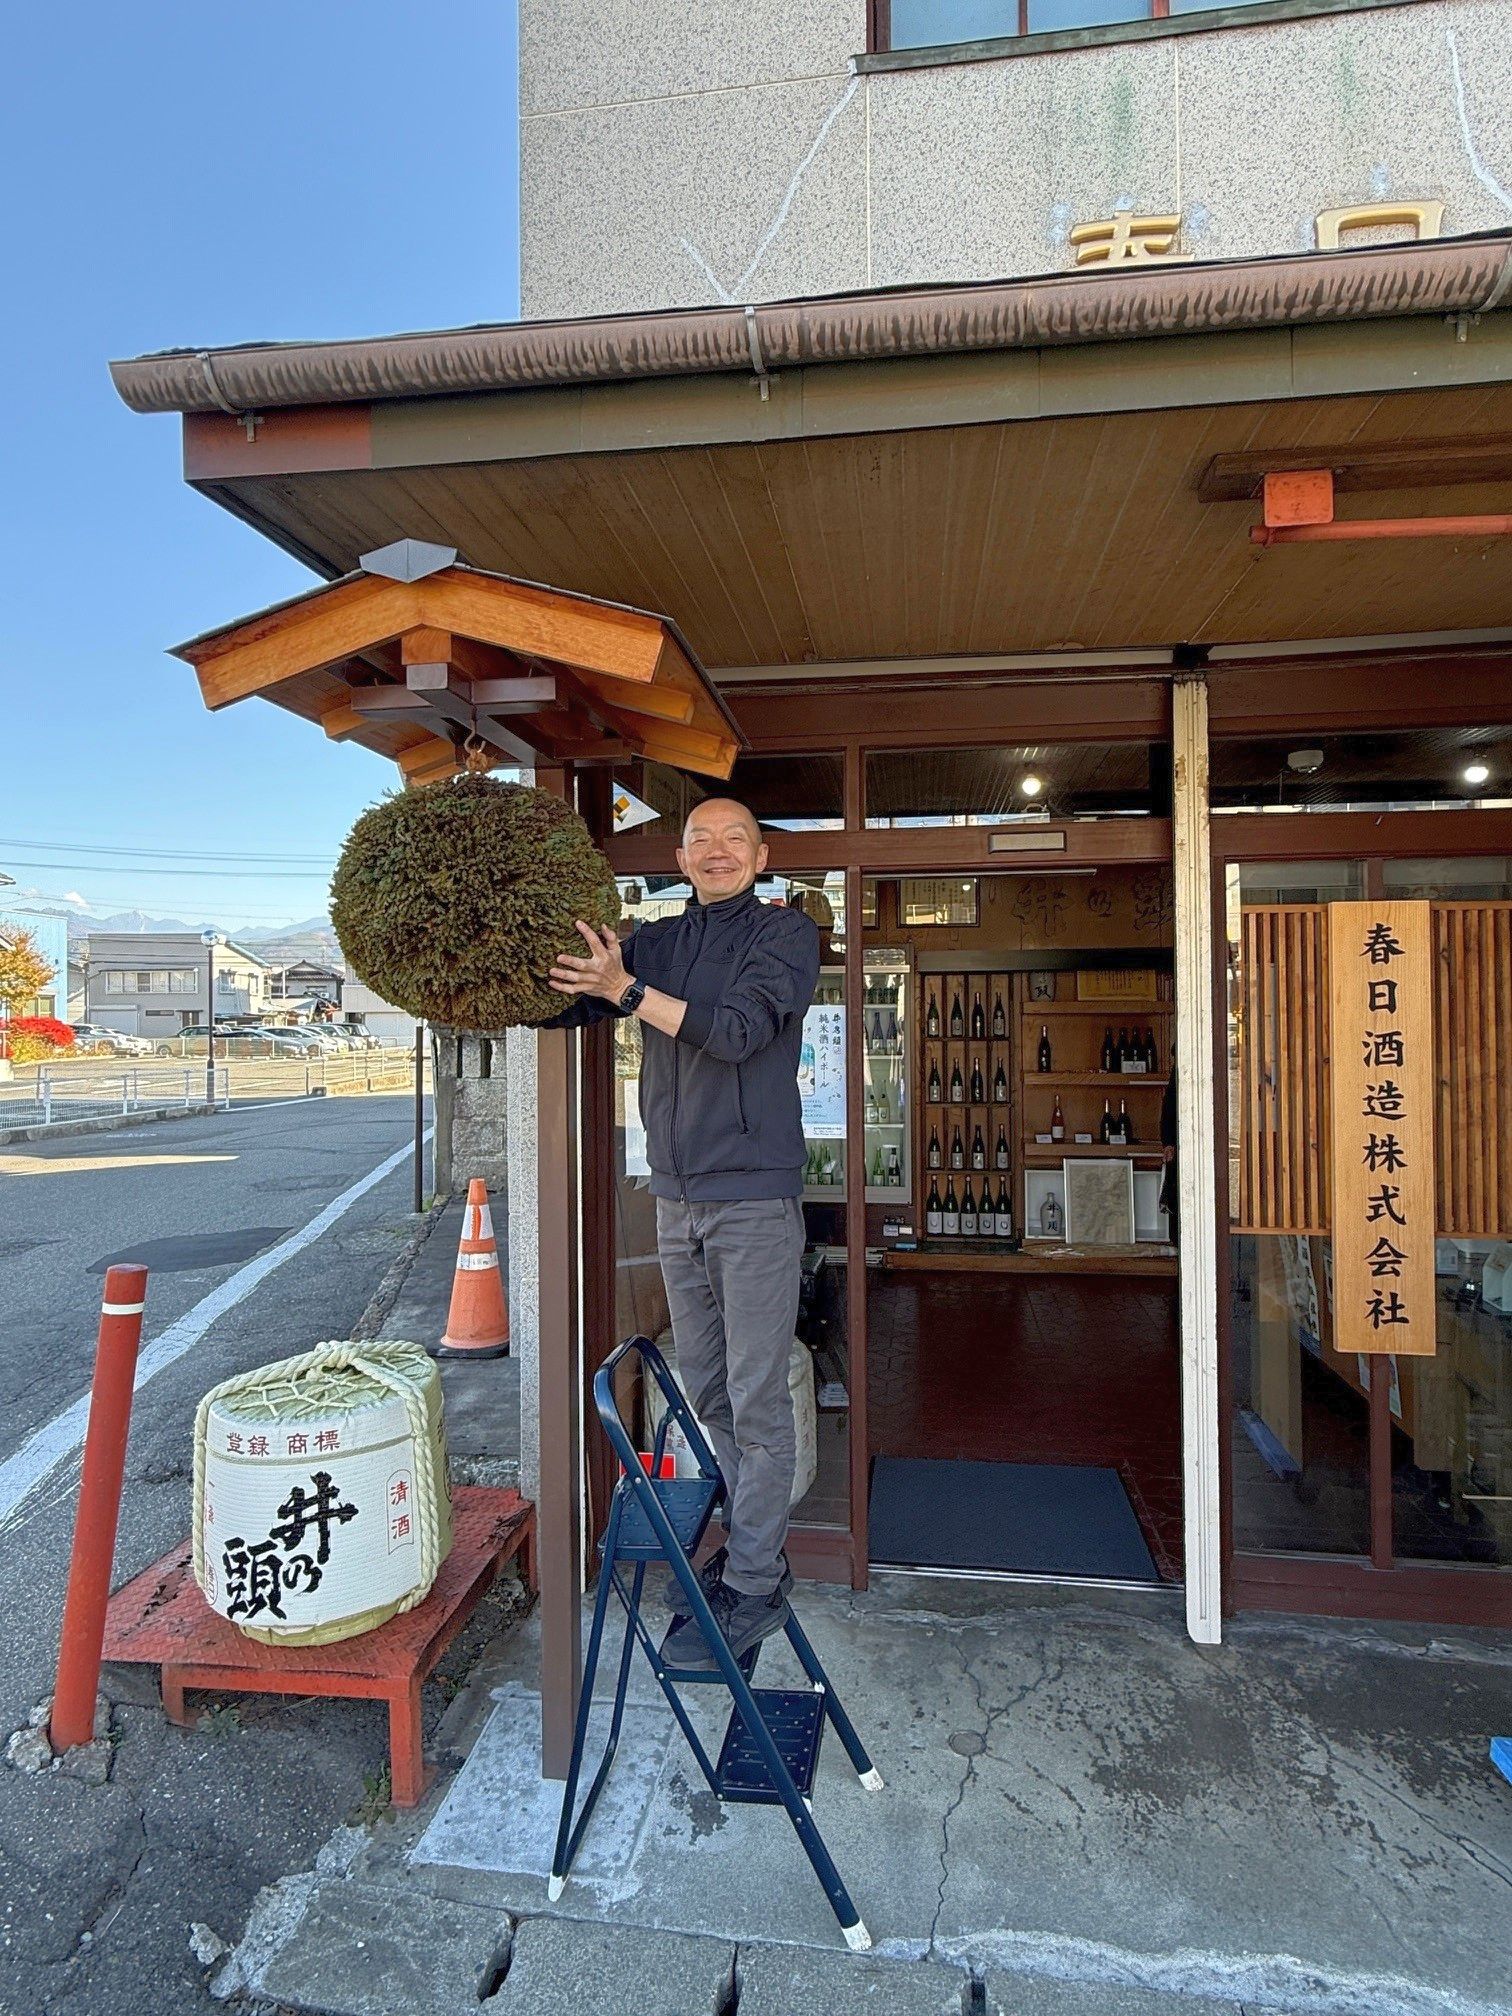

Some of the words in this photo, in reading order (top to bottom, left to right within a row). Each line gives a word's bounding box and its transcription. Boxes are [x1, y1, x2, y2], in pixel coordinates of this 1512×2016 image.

[818, 1013, 830, 1089] 純米酒ハイボール
[1359, 922, 1410, 1330] 春日酒造株式会社
[390, 1480, 410, 1540] 清酒
